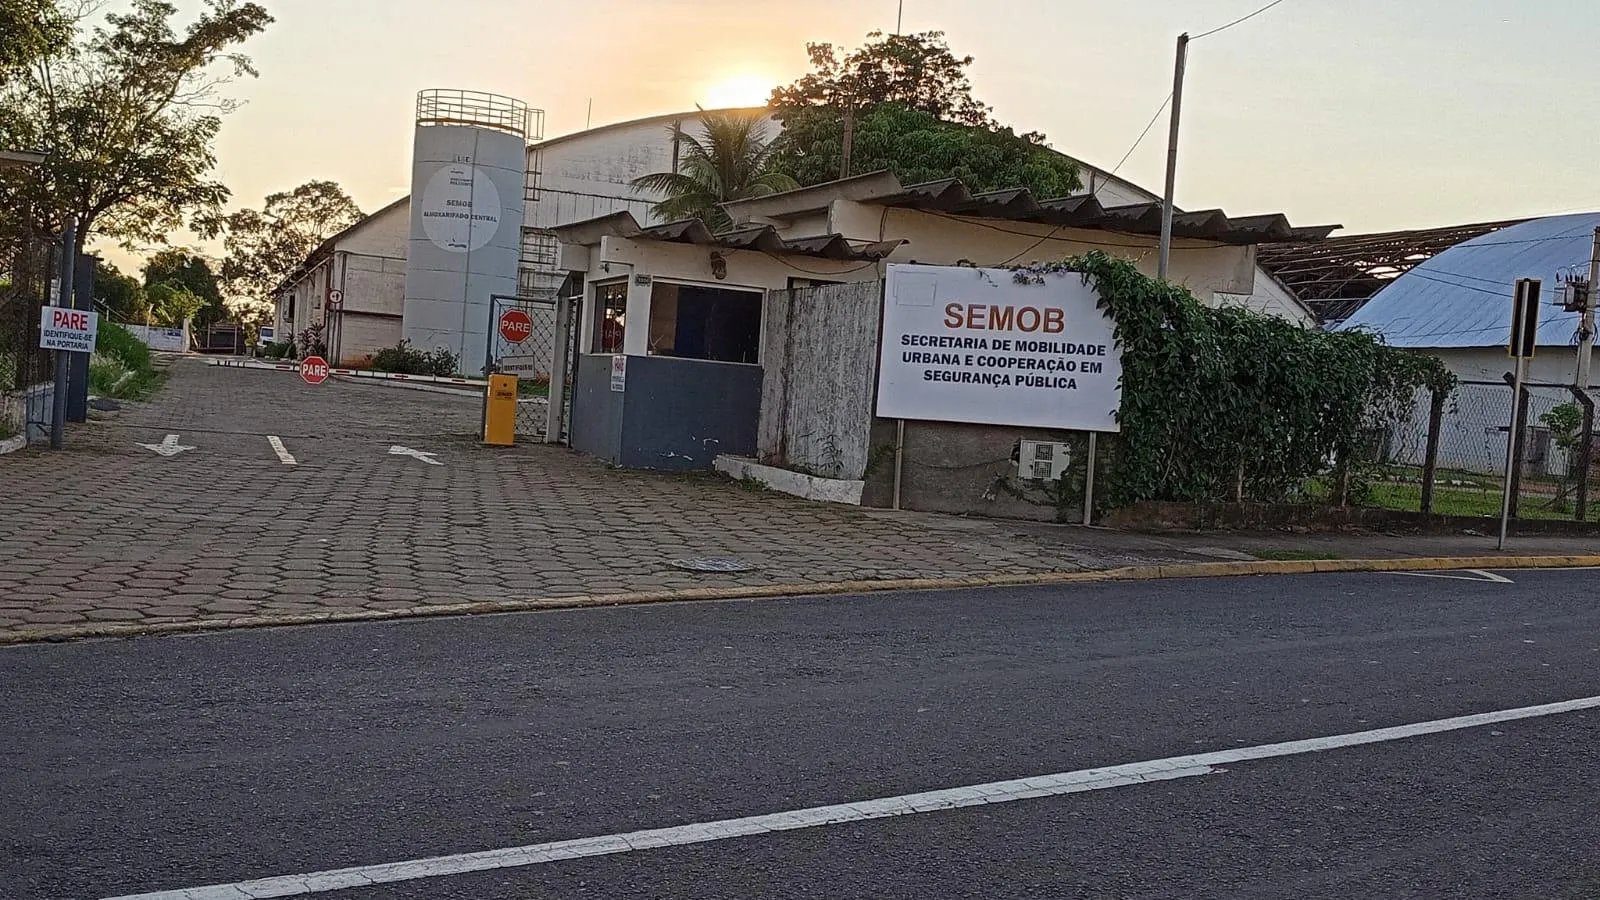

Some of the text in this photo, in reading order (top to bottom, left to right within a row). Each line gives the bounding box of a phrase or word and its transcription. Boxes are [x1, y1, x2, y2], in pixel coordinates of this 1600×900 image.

[470, 214, 497, 222] CENTRAL
[53, 310, 88, 331] PARE
[501, 320, 531, 333] PARE
[944, 303, 1065, 334] SEMOB
[44, 330, 92, 341] IDENTIFIQUE-SE
[57, 340, 88, 350] PORTARIA
[901, 335, 1106, 357] SECRETARIA DE MOBILIDADE
[302, 363, 326, 376] PARE
[902, 352, 1102, 374] URBANA E COOPERAÇÃO EM
[924, 370, 1077, 390] SEGURANÇA PÚBLICA
